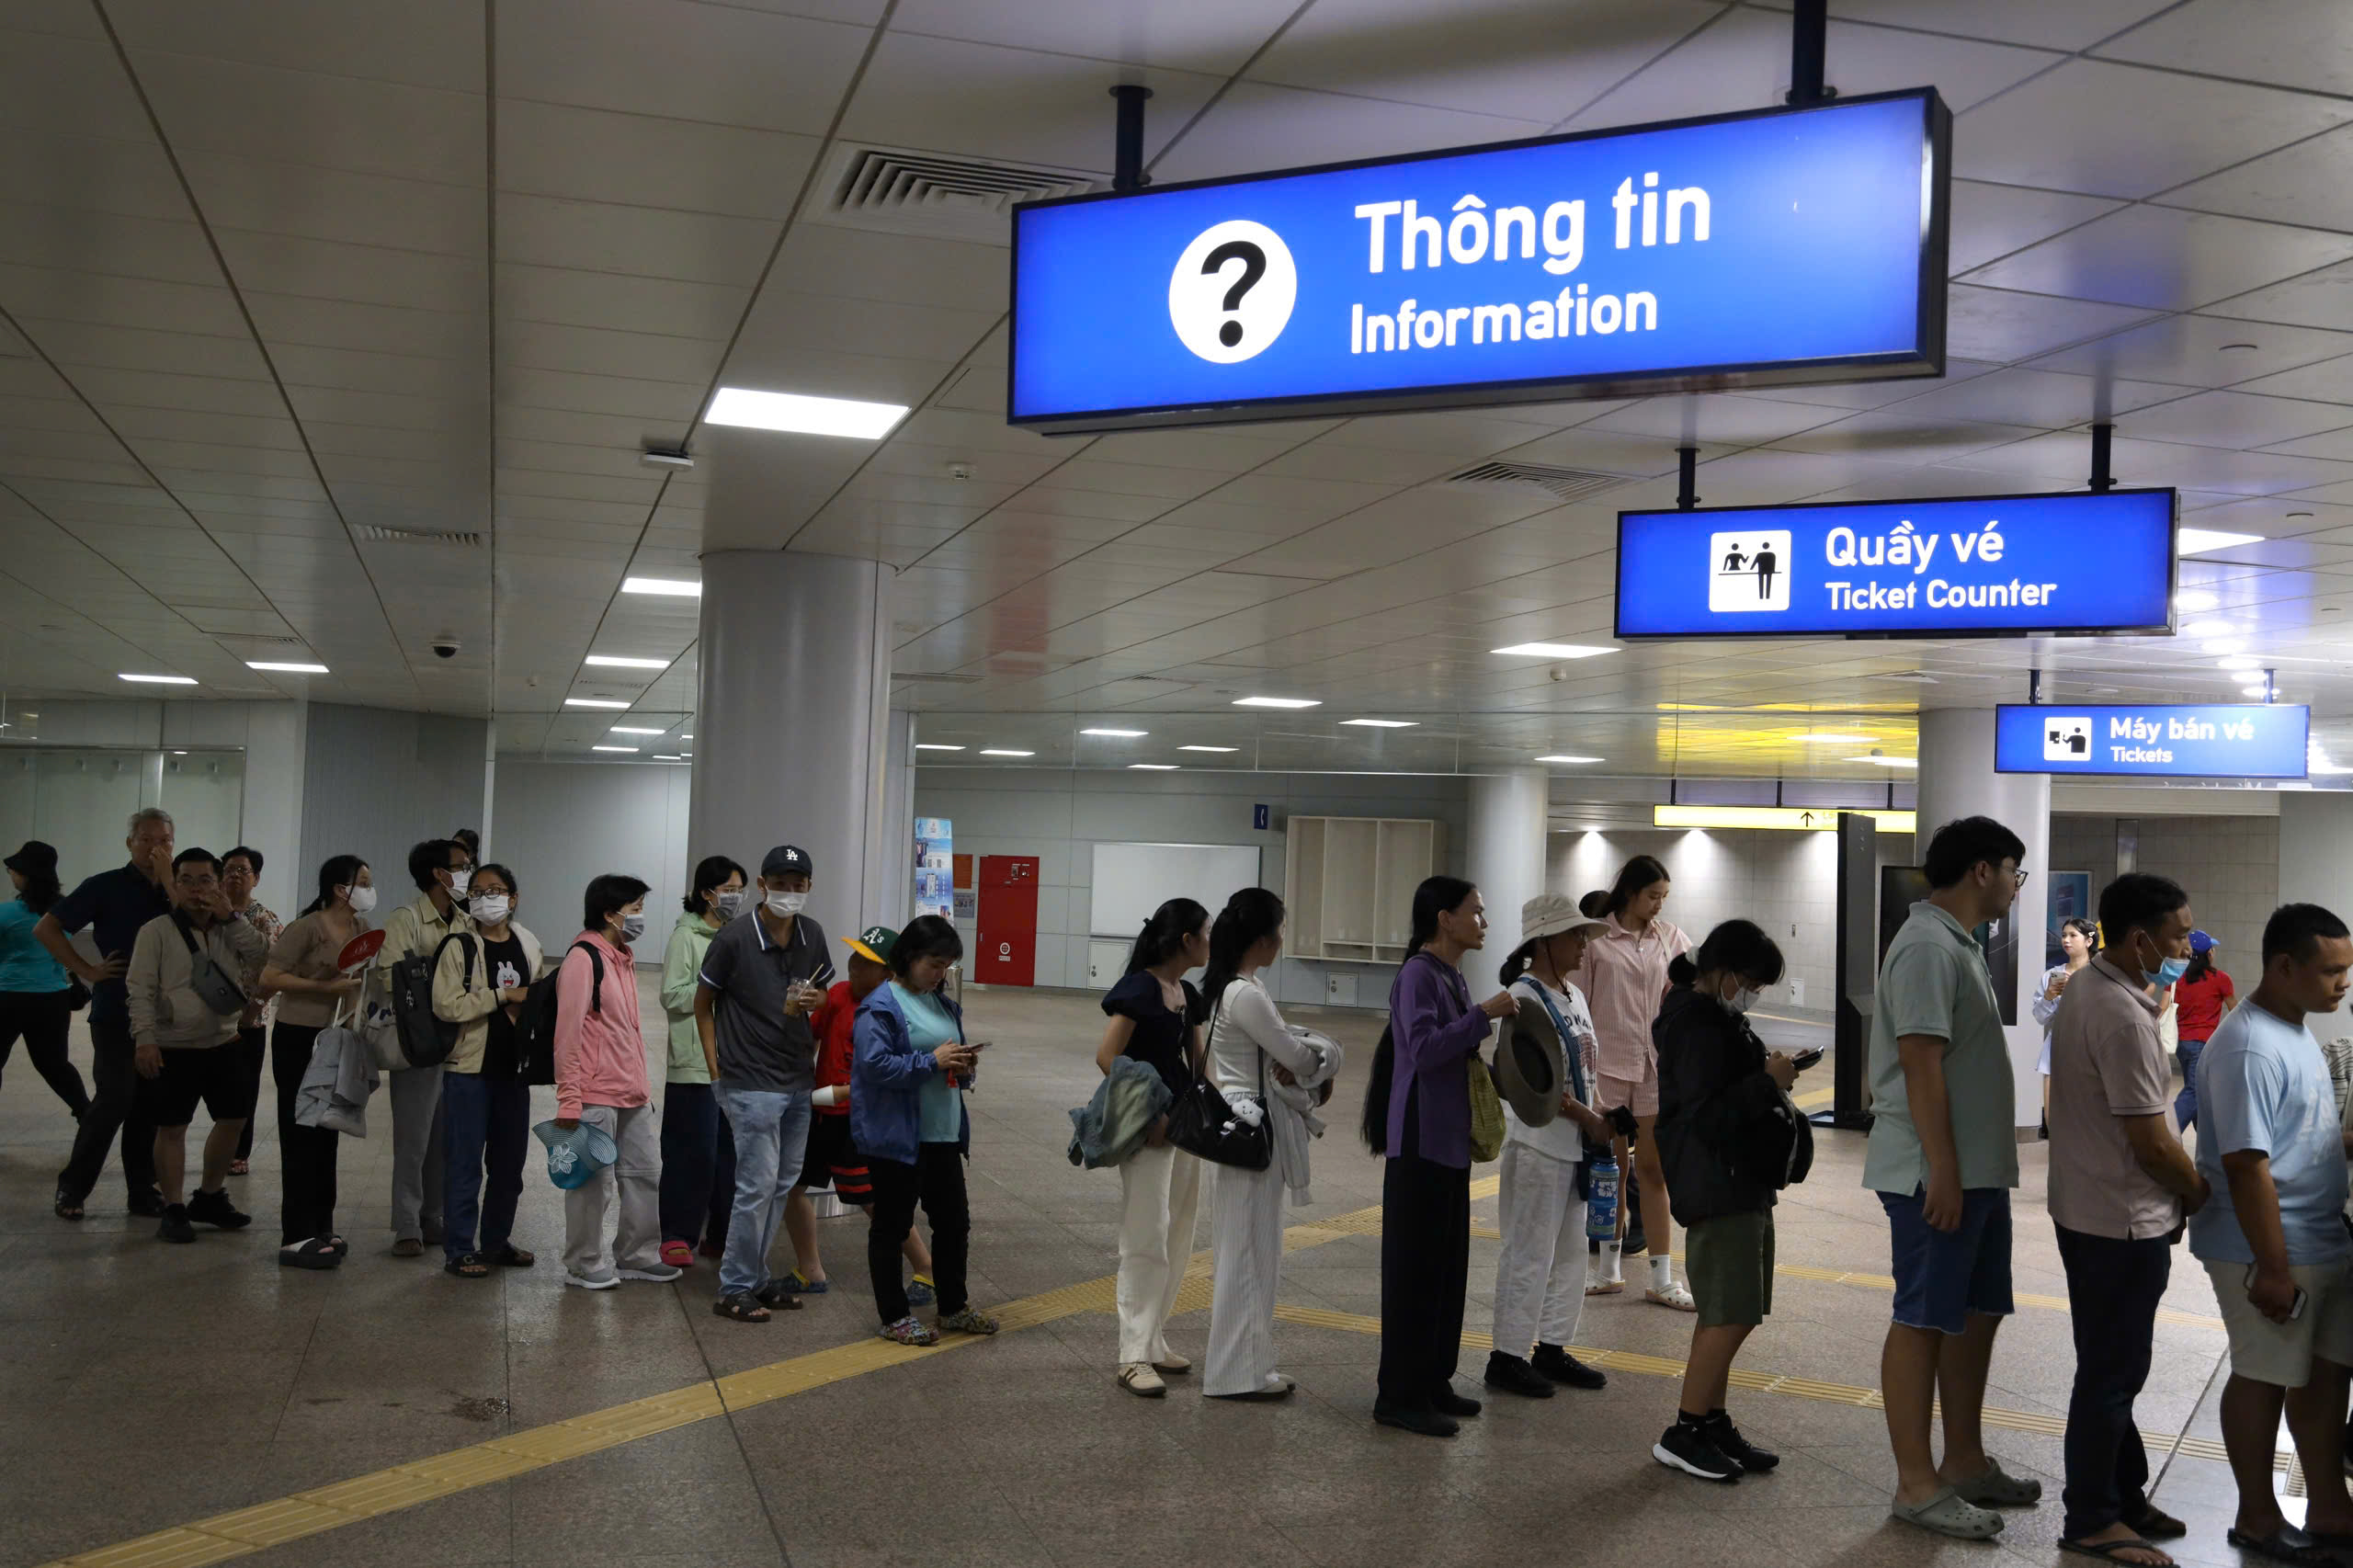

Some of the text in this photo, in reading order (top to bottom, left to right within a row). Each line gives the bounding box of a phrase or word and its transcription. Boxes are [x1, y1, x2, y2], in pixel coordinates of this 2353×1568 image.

[1354, 171, 1711, 276] Thông tin
[1350, 282, 1657, 354] Information
[1825, 519, 2005, 574] Quầy vé
[1824, 577, 2058, 610] Ticket Counter
[2109, 715, 2255, 745] Máy bán vé
[2110, 746, 2174, 763] Tickets
[786, 848, 799, 861] LA
